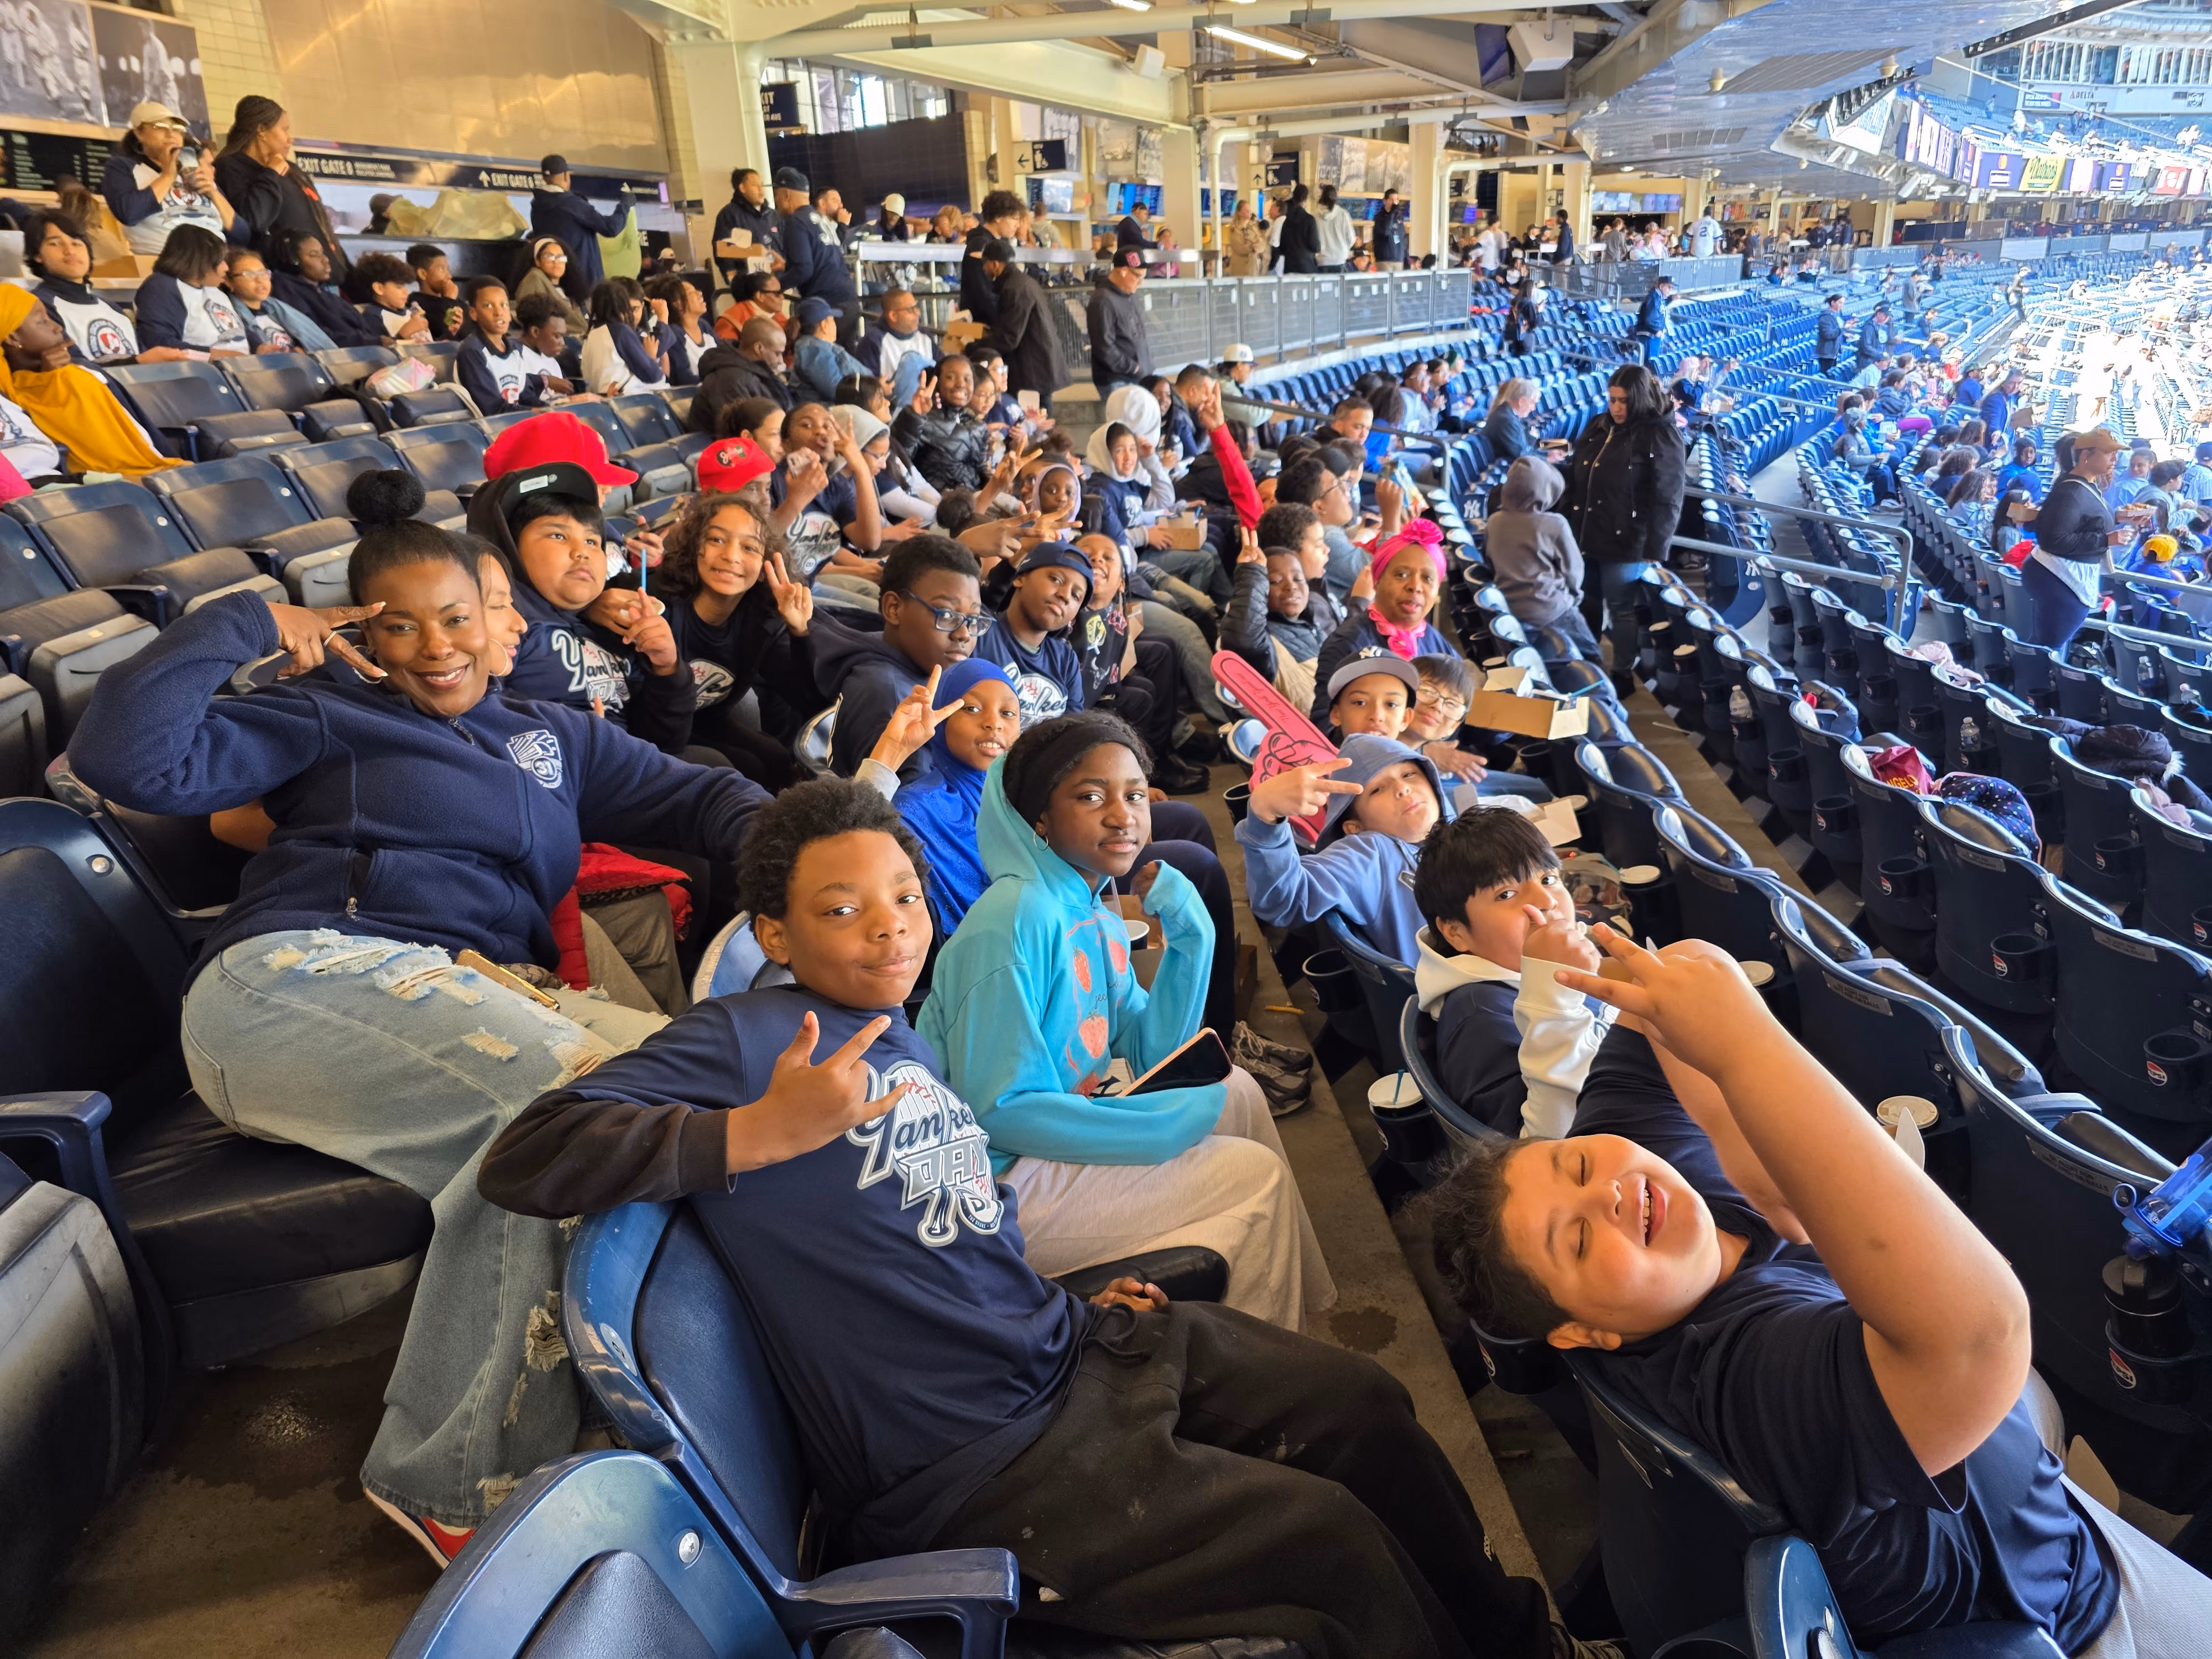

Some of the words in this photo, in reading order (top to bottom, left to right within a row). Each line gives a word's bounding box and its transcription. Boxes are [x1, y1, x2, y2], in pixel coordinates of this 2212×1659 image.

[321, 159, 347, 176] GATE
[508, 174, 528, 189] GATE
[1463, 499, 1481, 519] NY
[535, 760, 554, 776] 31
[1887, 775, 1919, 789] NGELO
[896, 1133, 990, 1211] DAY
